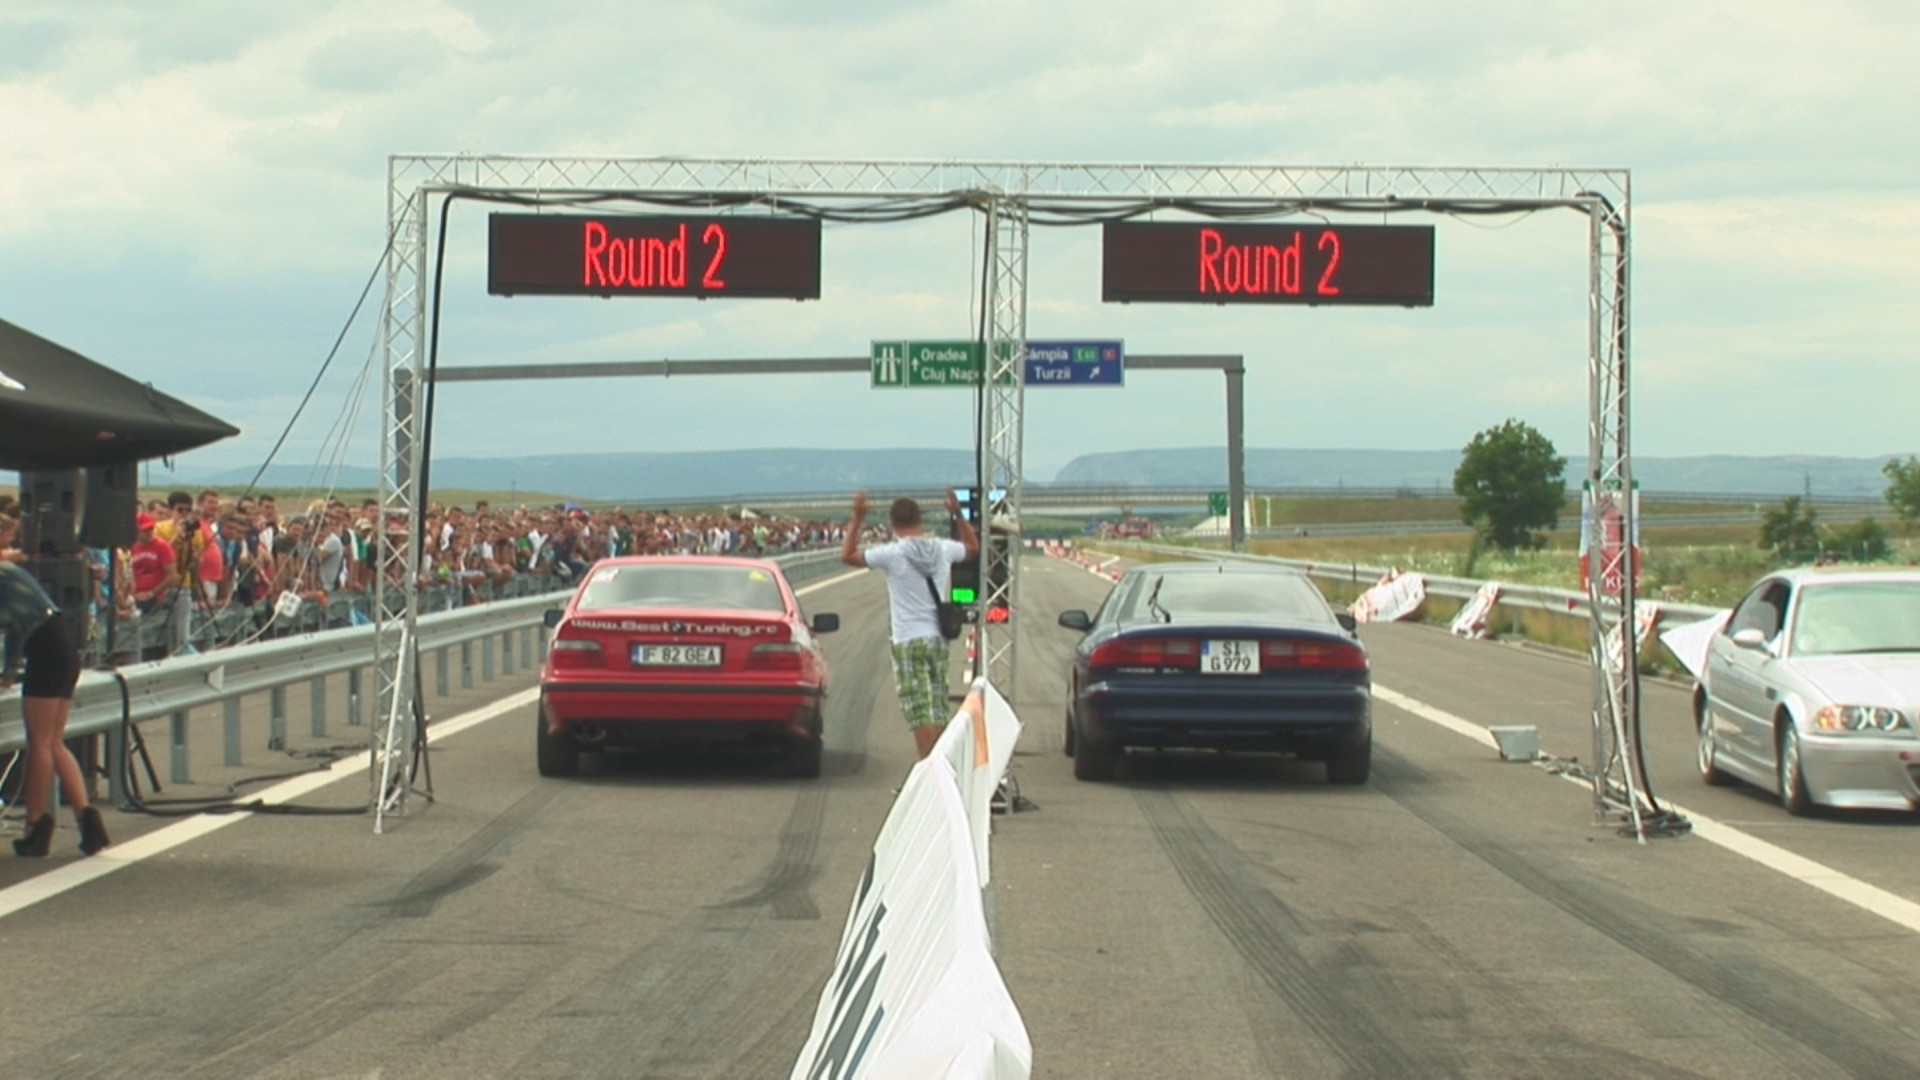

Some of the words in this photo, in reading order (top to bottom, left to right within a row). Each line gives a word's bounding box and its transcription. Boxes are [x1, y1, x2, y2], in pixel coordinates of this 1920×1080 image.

[584, 221, 686, 287] Round
[702, 223, 725, 289] 2
[1200, 228, 1300, 293] Round
[1317, 229, 1340, 295] 2
[921, 347, 967, 361] Oradea
[921, 366, 946, 383] Cluj
[1033, 366, 1071, 379] Turzii
[662, 646, 681, 662] 82
[684, 646, 717, 663] GEA
[1223, 656, 1252, 671] 979
